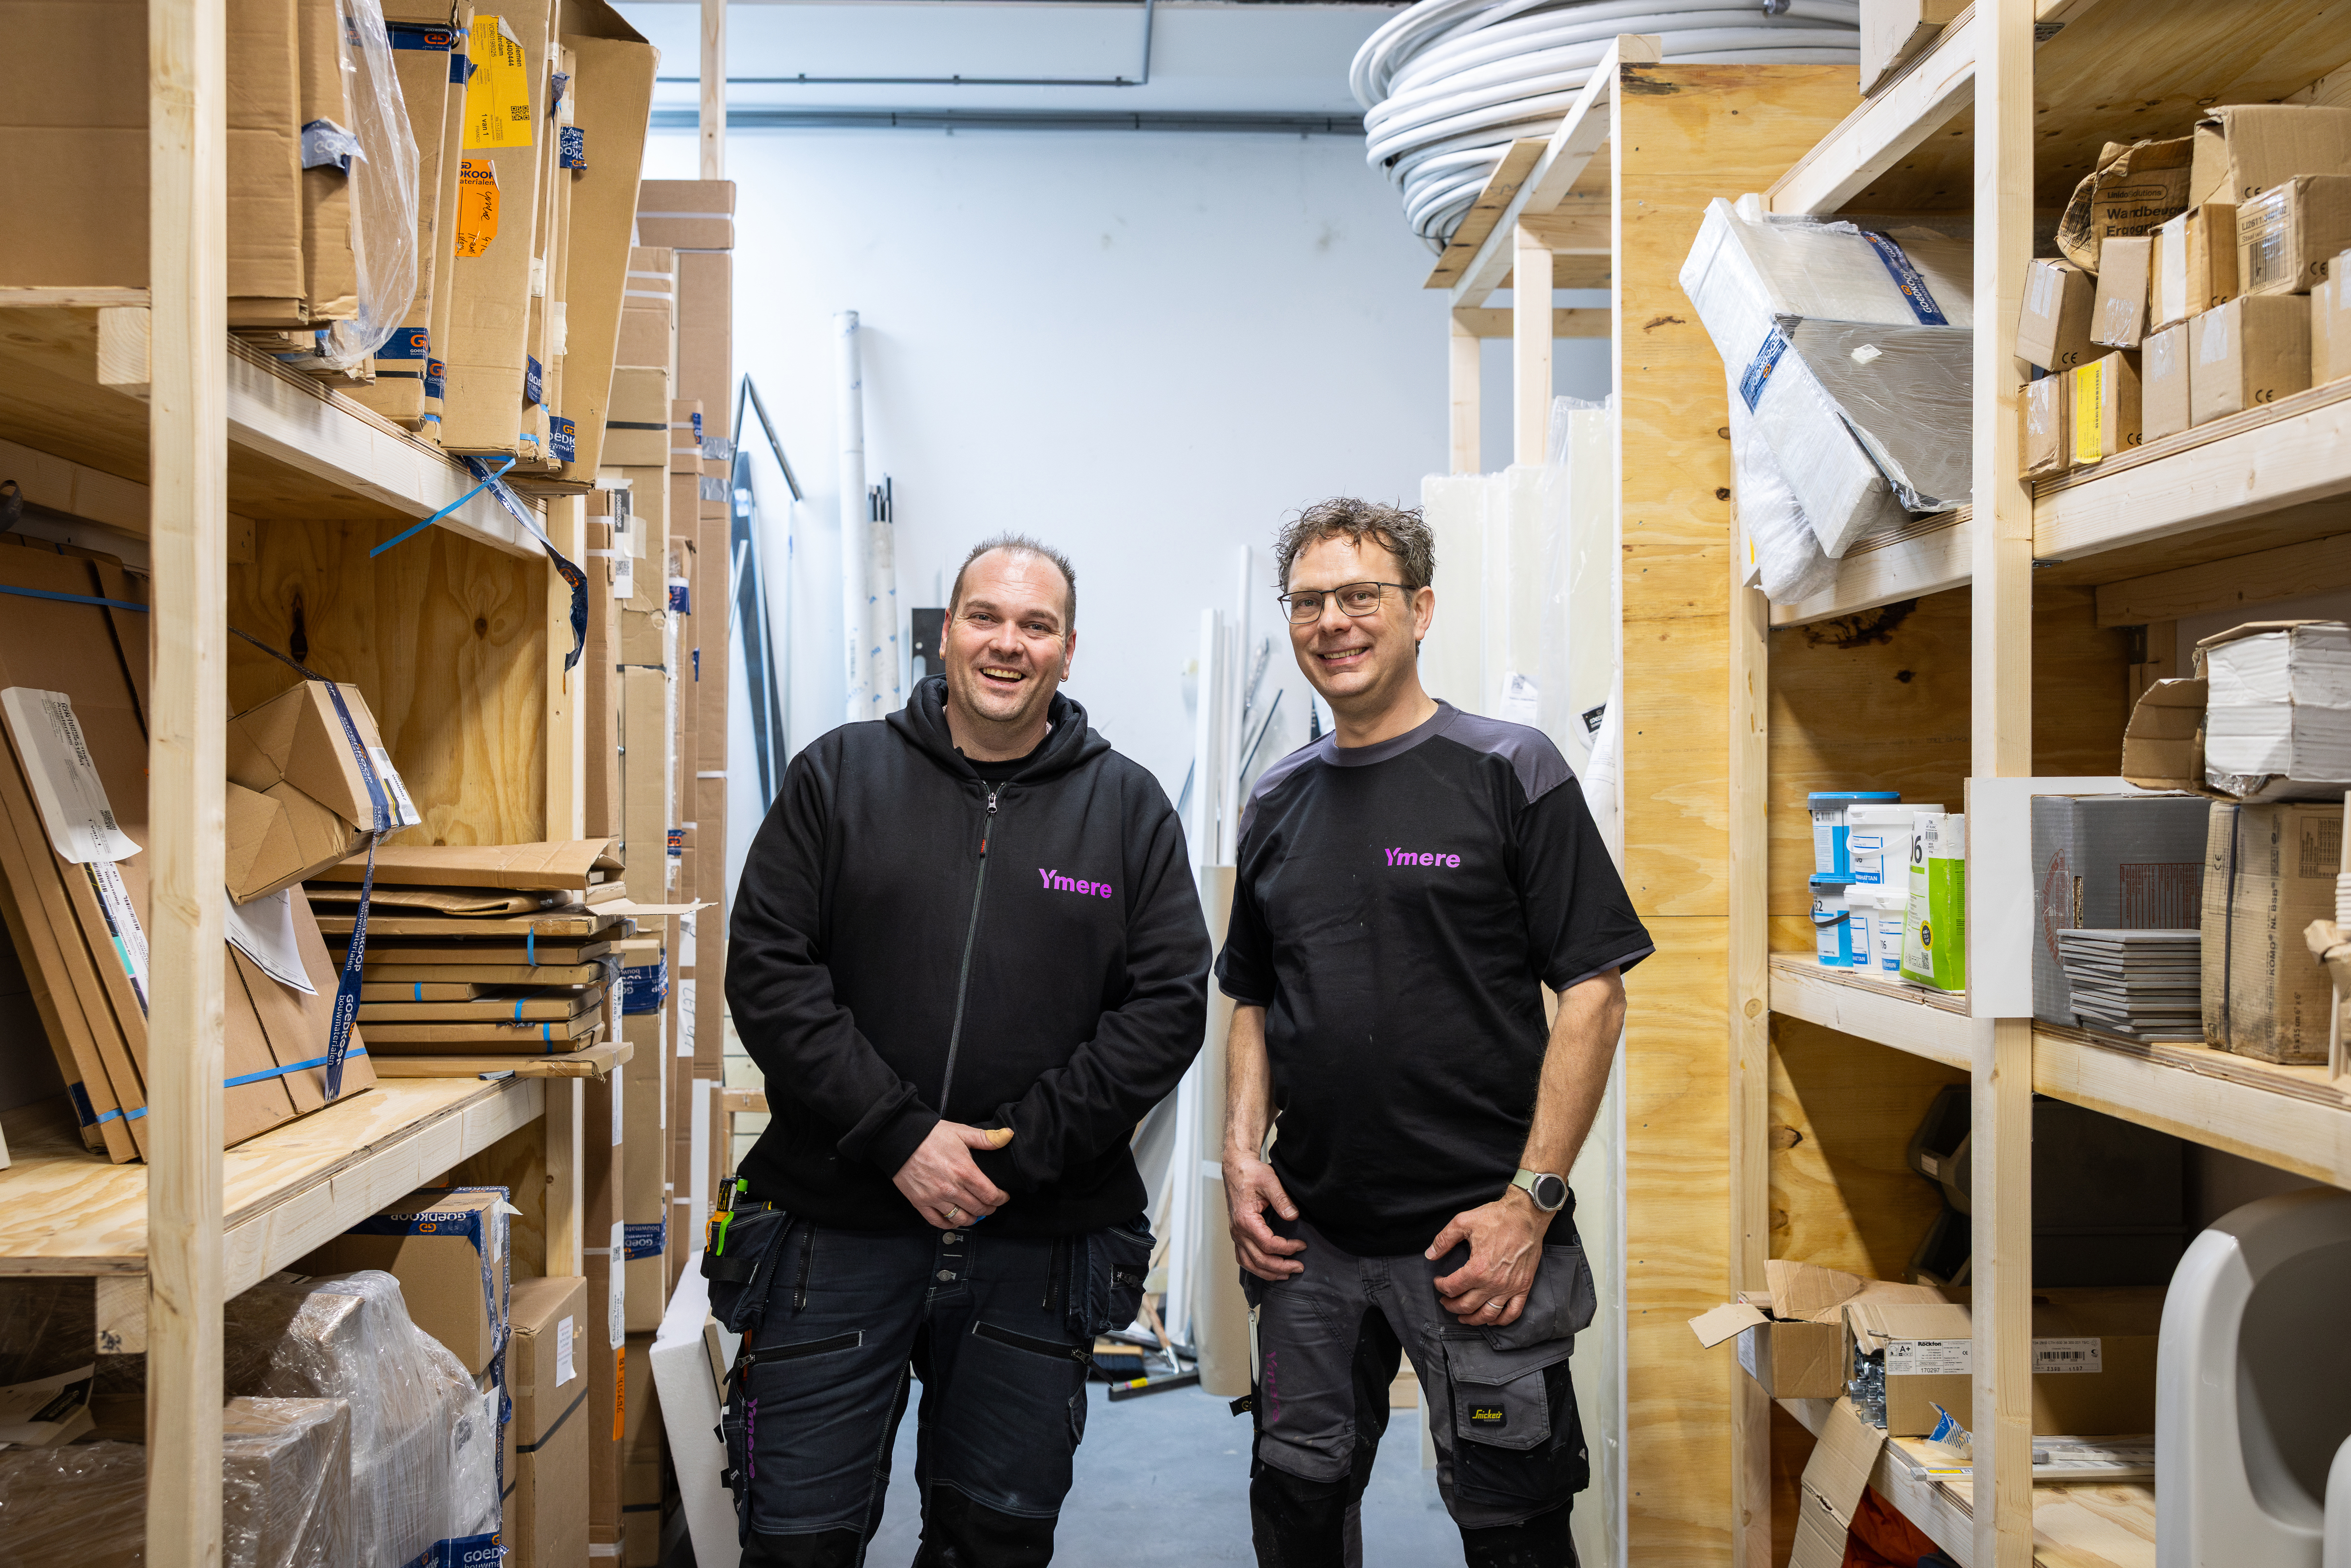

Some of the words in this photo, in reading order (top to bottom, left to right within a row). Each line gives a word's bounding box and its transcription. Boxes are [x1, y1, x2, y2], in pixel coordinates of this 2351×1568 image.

[488, 23, 497, 58] VOR0198025
[2242, 232, 2255, 243] Staal
[1900, 269, 1932, 313] GOEDKOOP
[340, 717, 368, 782] bouwmaterialen
[343, 717, 372, 784] GOEDKOOP
[90, 832, 100, 855] FRANCO
[1384, 847, 1460, 868] Ymere
[1038, 868, 1112, 899] Ymere
[346, 902, 367, 971] bouwmaterialen
[355, 900, 369, 972] GOEDKOOP
[2270, 915, 2276, 929] NL
[328, 995, 346, 1066] bouwmaterialen
[337, 994, 354, 1065] GOEDKOOP
[2293, 1028, 2301, 1037] 15
[2294, 1016, 2300, 1027] cm
[390, 1212, 466, 1221] GOEDKOOP
[1265, 1351, 1281, 1423] Ymere
[1472, 1409, 1502, 1419] Snickers
[745, 1396, 759, 1479] Ymere
